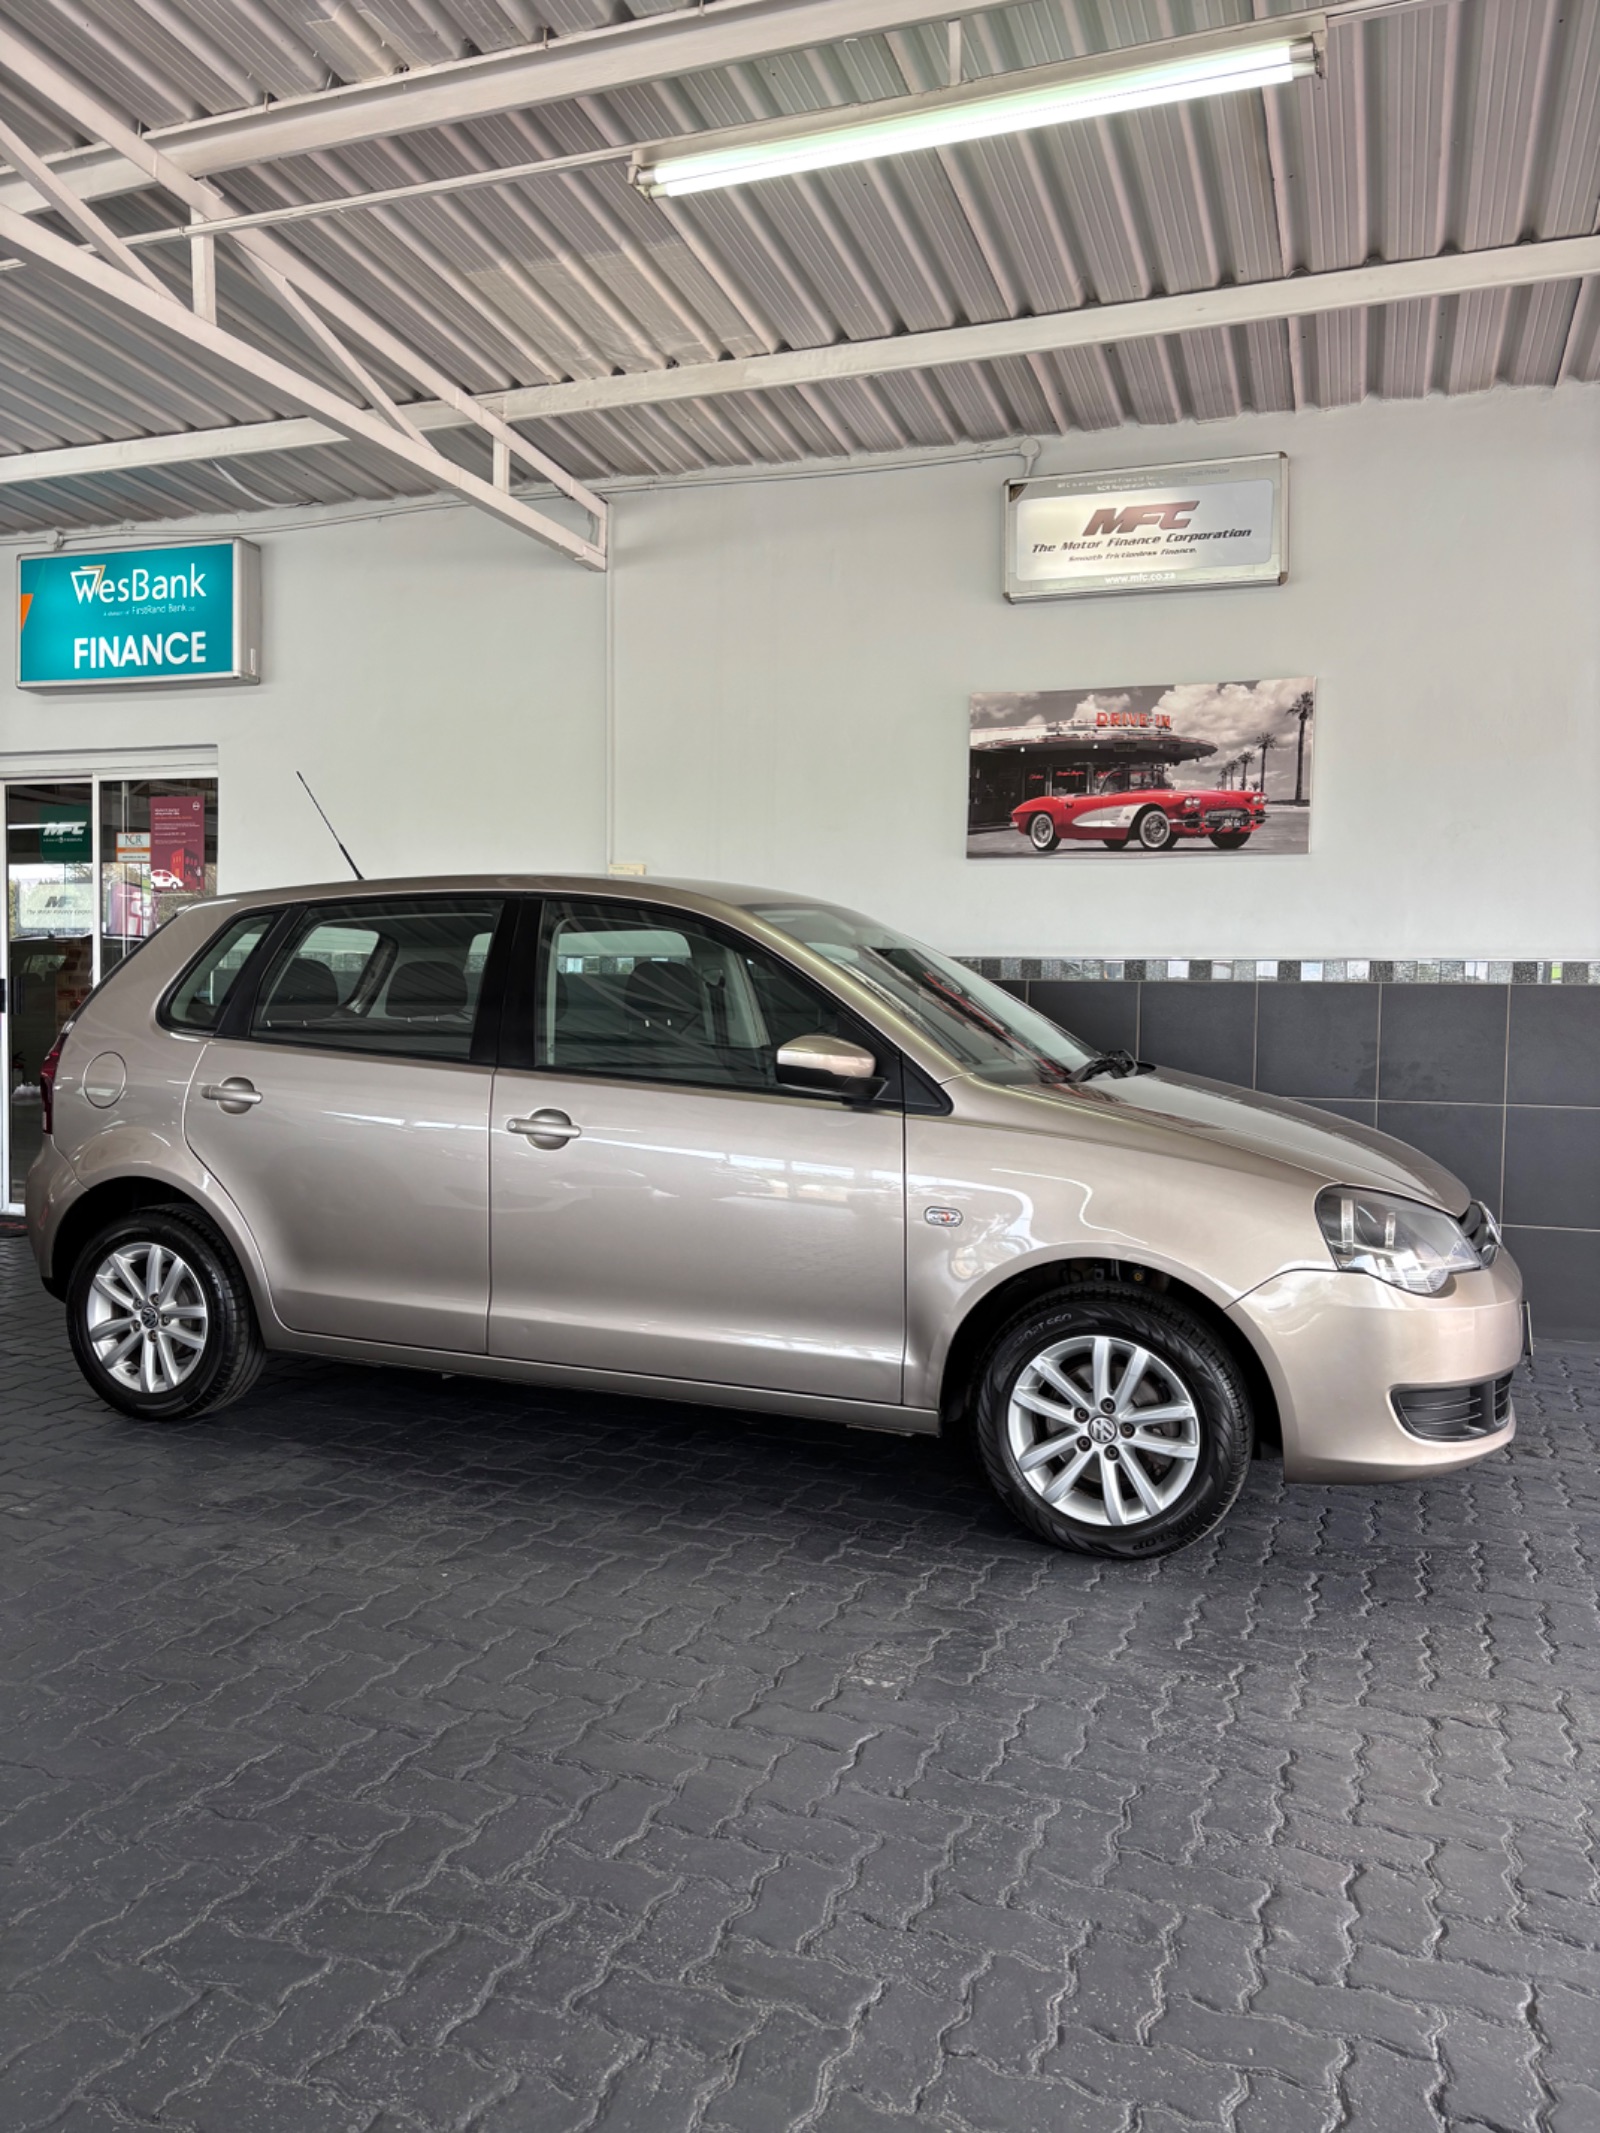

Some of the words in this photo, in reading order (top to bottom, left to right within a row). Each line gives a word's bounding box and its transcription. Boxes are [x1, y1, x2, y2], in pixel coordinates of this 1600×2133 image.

[1082, 500, 1200, 537] MFC
[1032, 543, 1056, 553] The
[1060, 541, 1103, 551] Motor
[1107, 536, 1161, 548] Finance
[1166, 528, 1252, 543] Corporation
[70, 563, 206, 604] WesBank
[1104, 572, 1177, 584] www.mfc.co.za
[168, 603, 187, 613] Bank
[74, 631, 206, 669] FINANCE
[1096, 712, 1171, 727] DRIVE-IN
[43, 822, 87, 836] MFC
[125, 835, 142, 844] NCR
